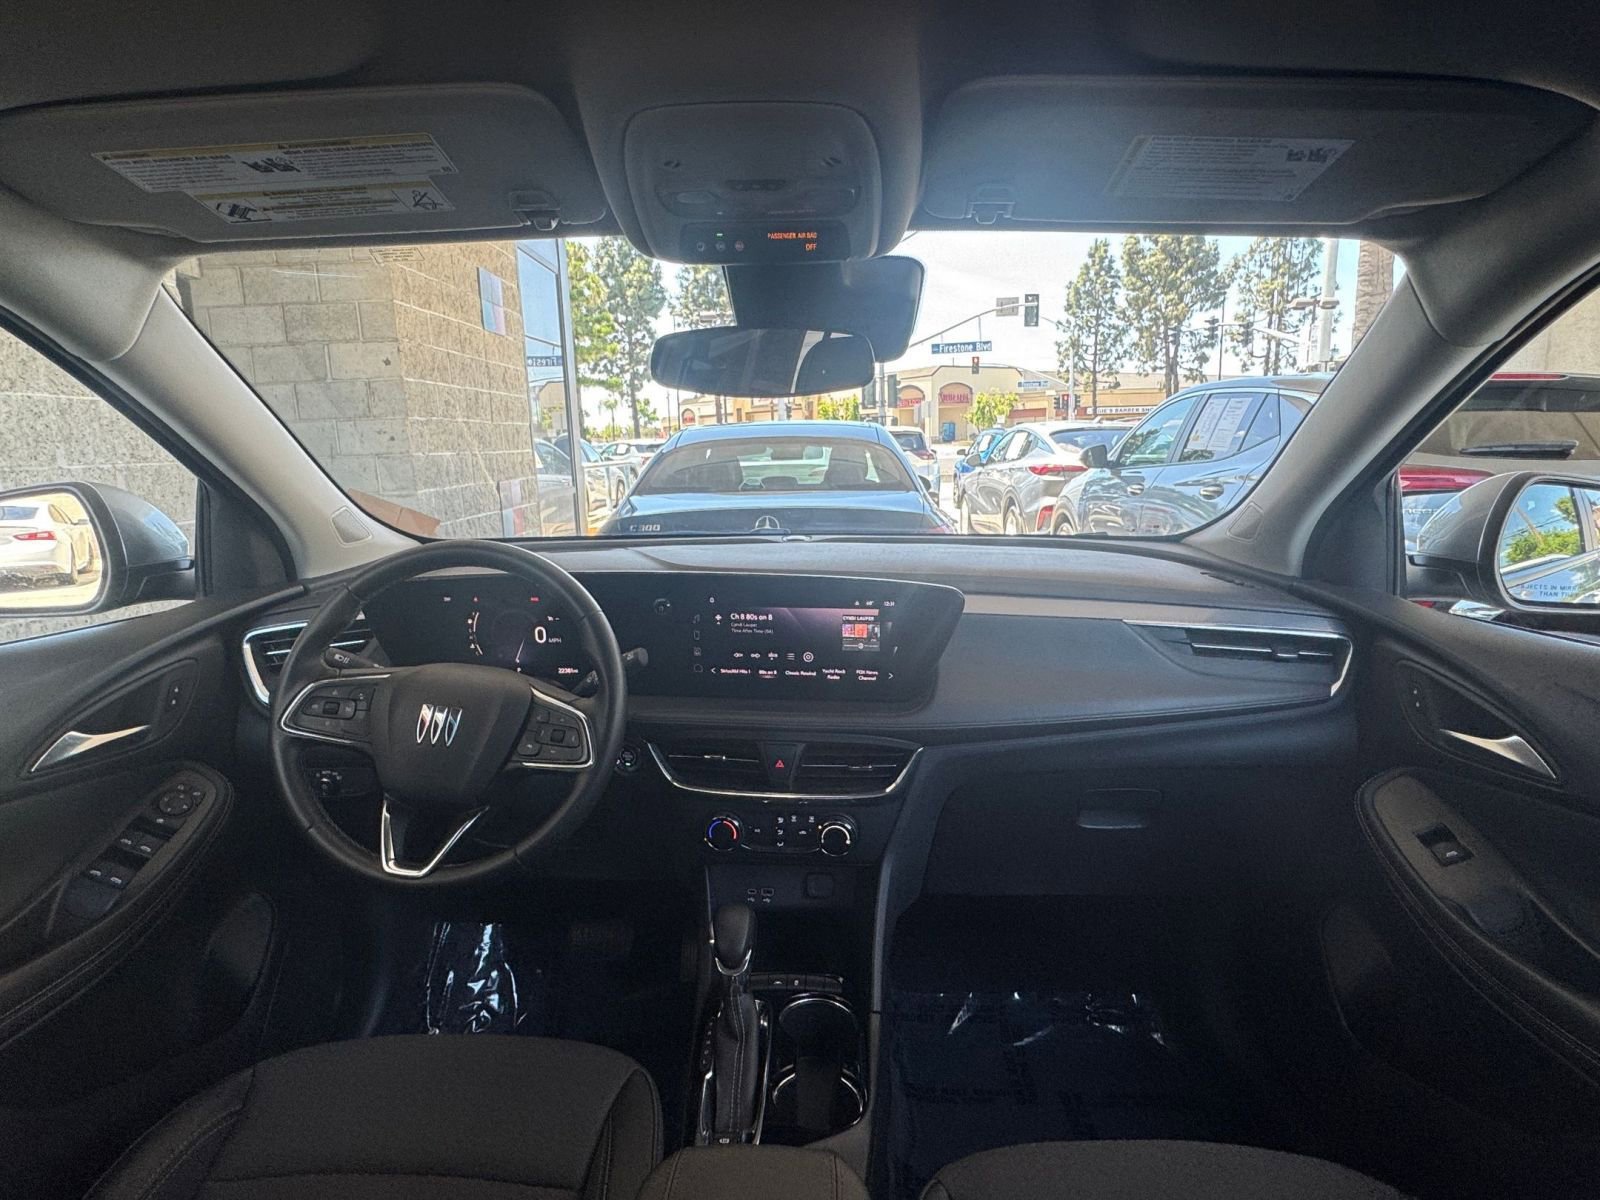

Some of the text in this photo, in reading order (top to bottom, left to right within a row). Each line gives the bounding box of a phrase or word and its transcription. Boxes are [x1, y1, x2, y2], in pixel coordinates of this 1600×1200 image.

[805, 243, 816, 251] OFF
[940, 342, 991, 353] Firestone Blvd
[629, 524, 637, 532] C
[535, 626, 546, 643] 0
